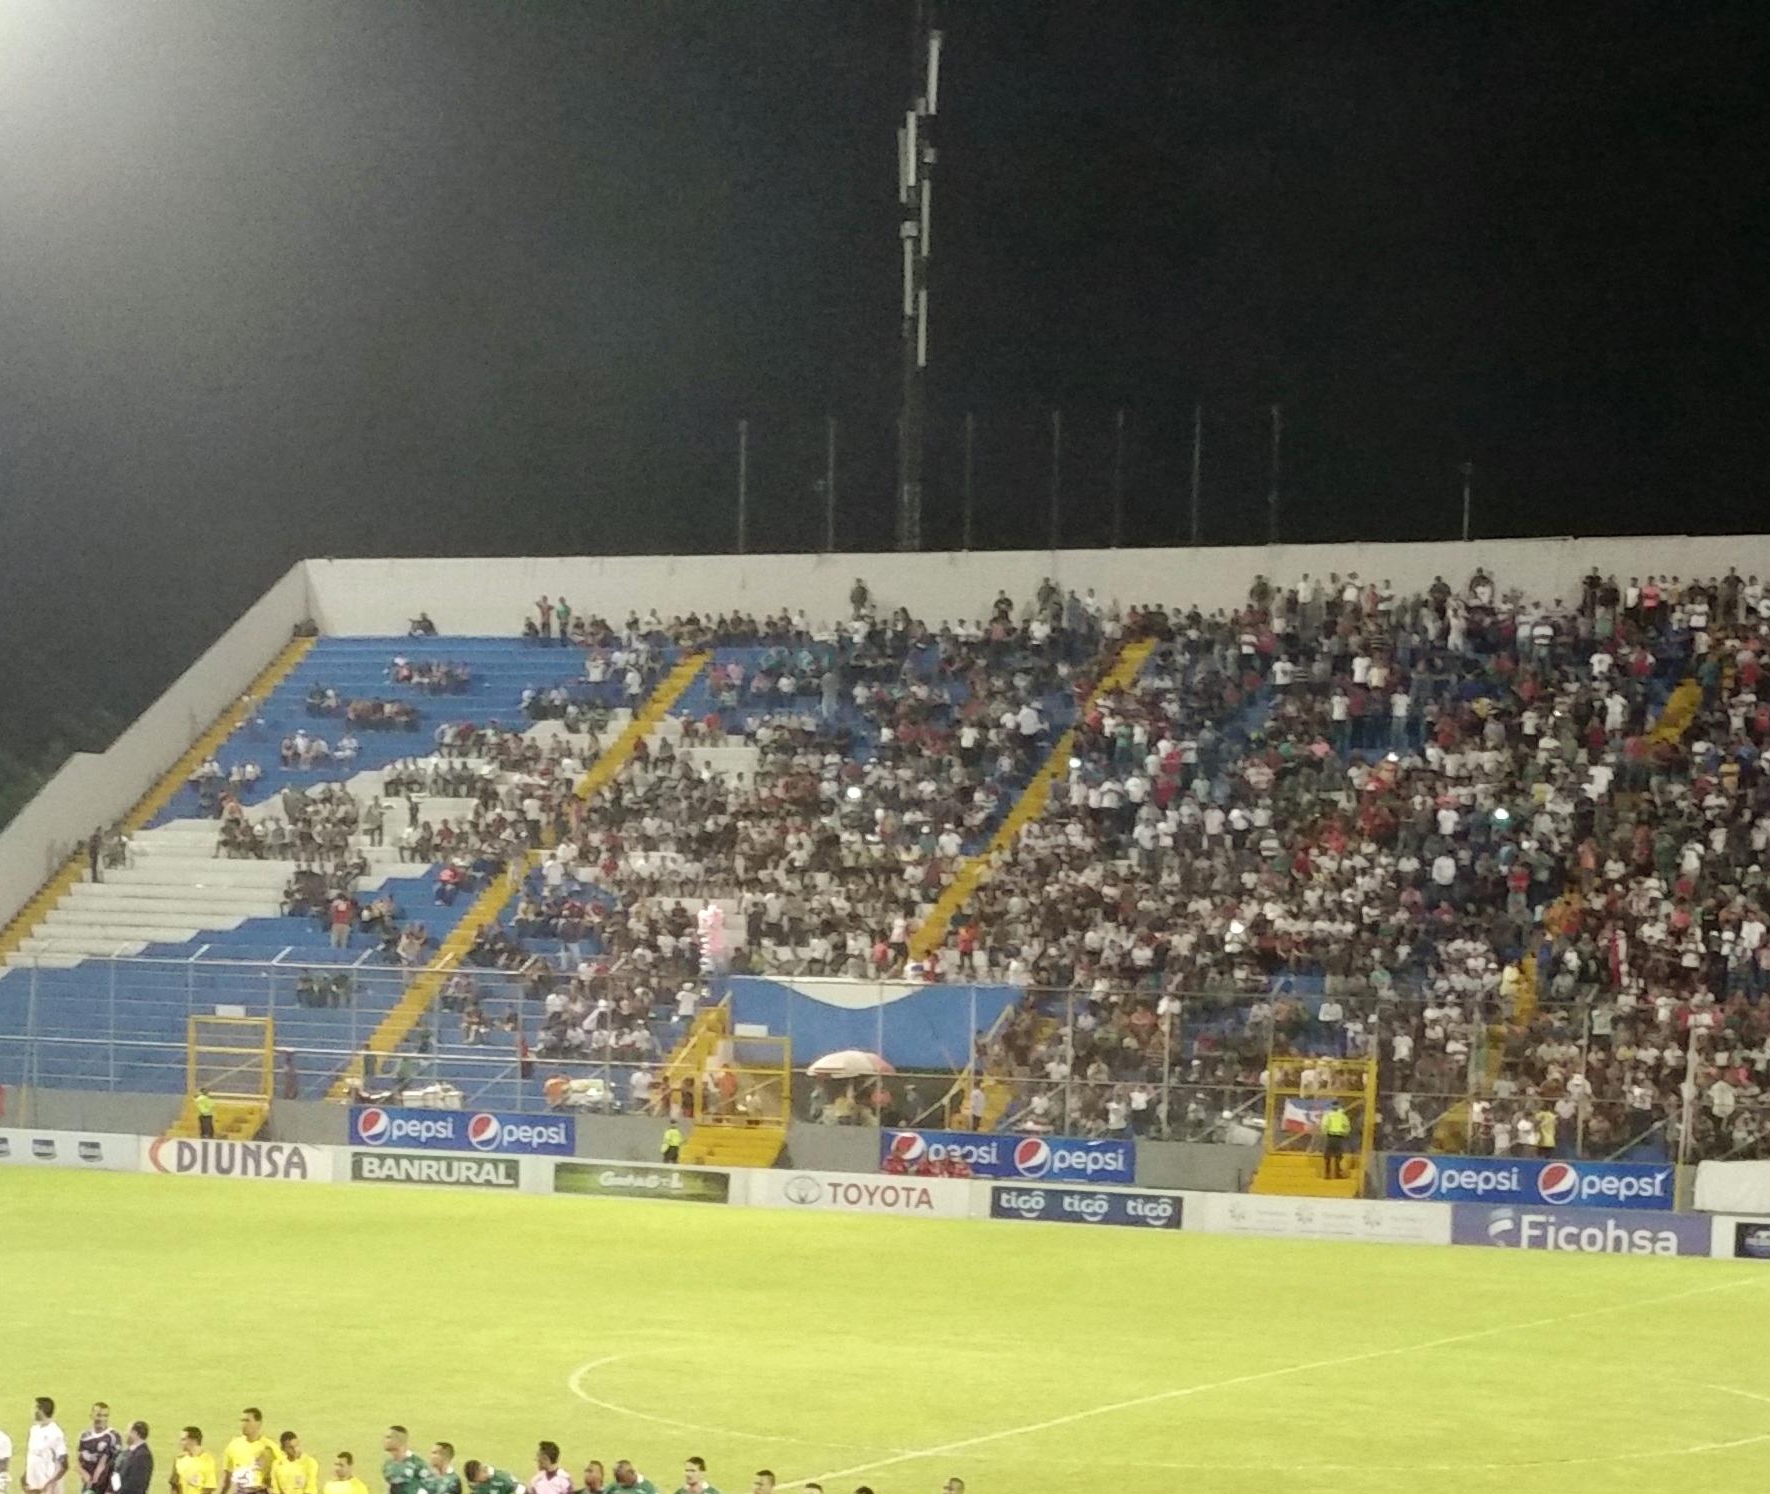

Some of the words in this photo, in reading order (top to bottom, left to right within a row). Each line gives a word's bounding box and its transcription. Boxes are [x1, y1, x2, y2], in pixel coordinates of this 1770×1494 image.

[392, 1116, 454, 1142] pepsi
[502, 1121, 568, 1149] pepsi
[175, 1141, 308, 1180] DIUNSA
[361, 1156, 516, 1186] BANRURAL
[1052, 1147, 1125, 1175] pepsi
[827, 1182, 934, 1209] TOYOTA
[1440, 1165, 1521, 1194] pepsi
[1581, 1171, 1666, 1201] pepsi
[1520, 1213, 1680, 1256] Ficohsa
